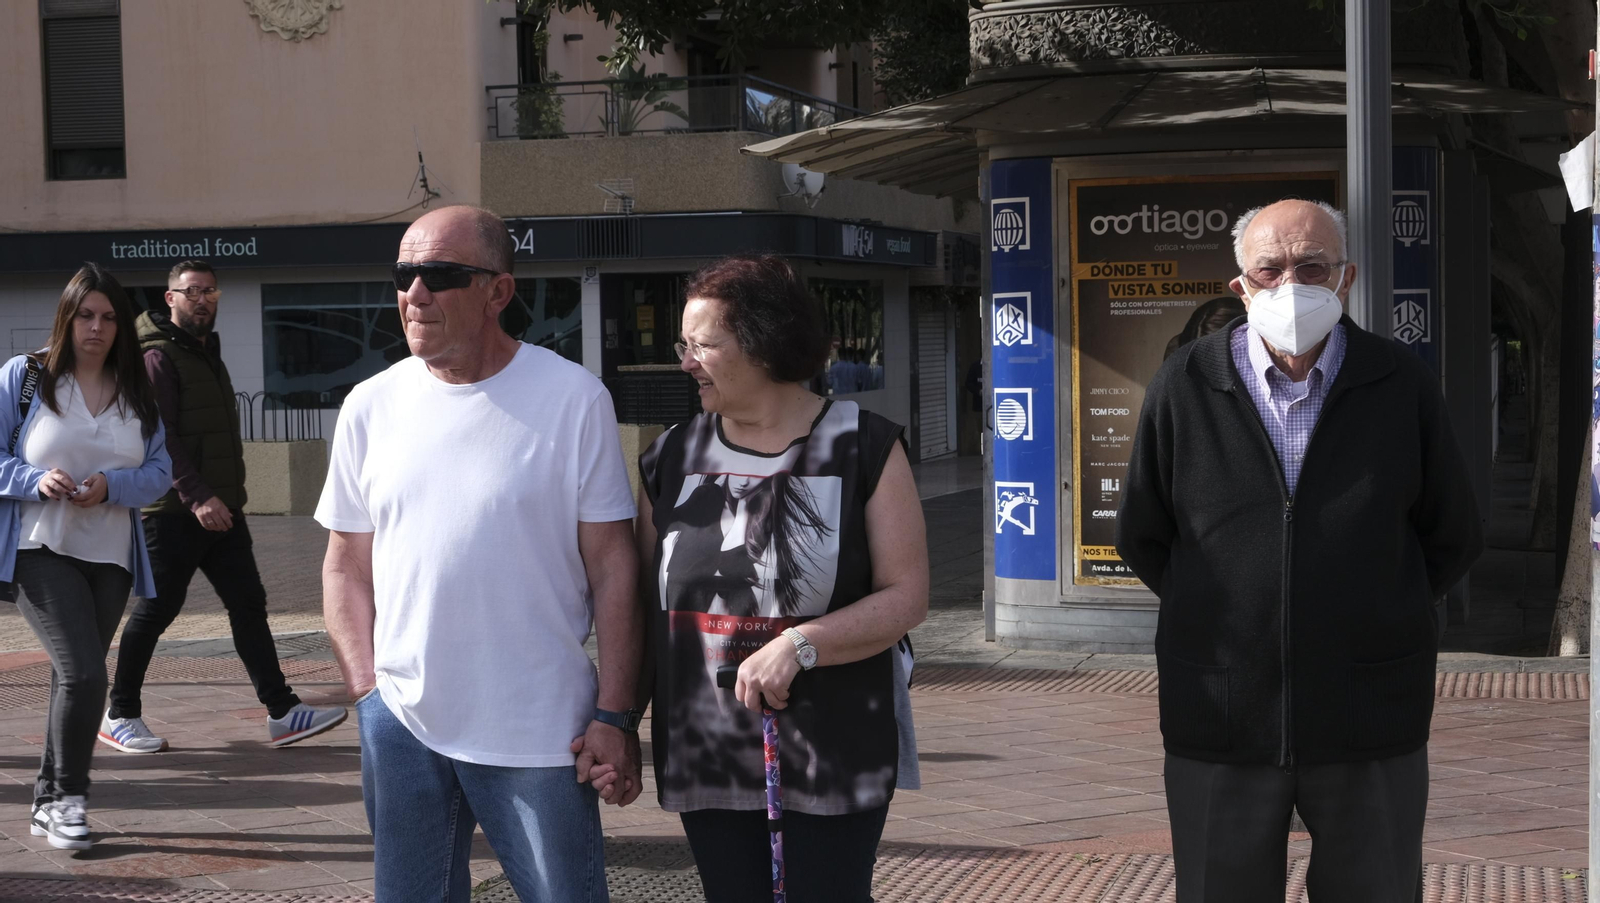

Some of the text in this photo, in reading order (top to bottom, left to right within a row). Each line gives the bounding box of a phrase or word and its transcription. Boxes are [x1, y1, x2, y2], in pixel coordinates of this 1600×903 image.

[111, 237, 258, 259] traditional food
[1154, 242, 1219, 252] óptica eyewear
[1090, 261, 1172, 277] DÓNDE TU
[1110, 282, 1223, 296] VISTA SONRIE
[1110, 300, 1127, 308] SÓLO
[1089, 408, 1130, 416] TOM FORD
[1091, 434, 1131, 443] kate spade
[1083, 548, 1101, 556] NOS
[1091, 564, 1114, 572] Avda.
